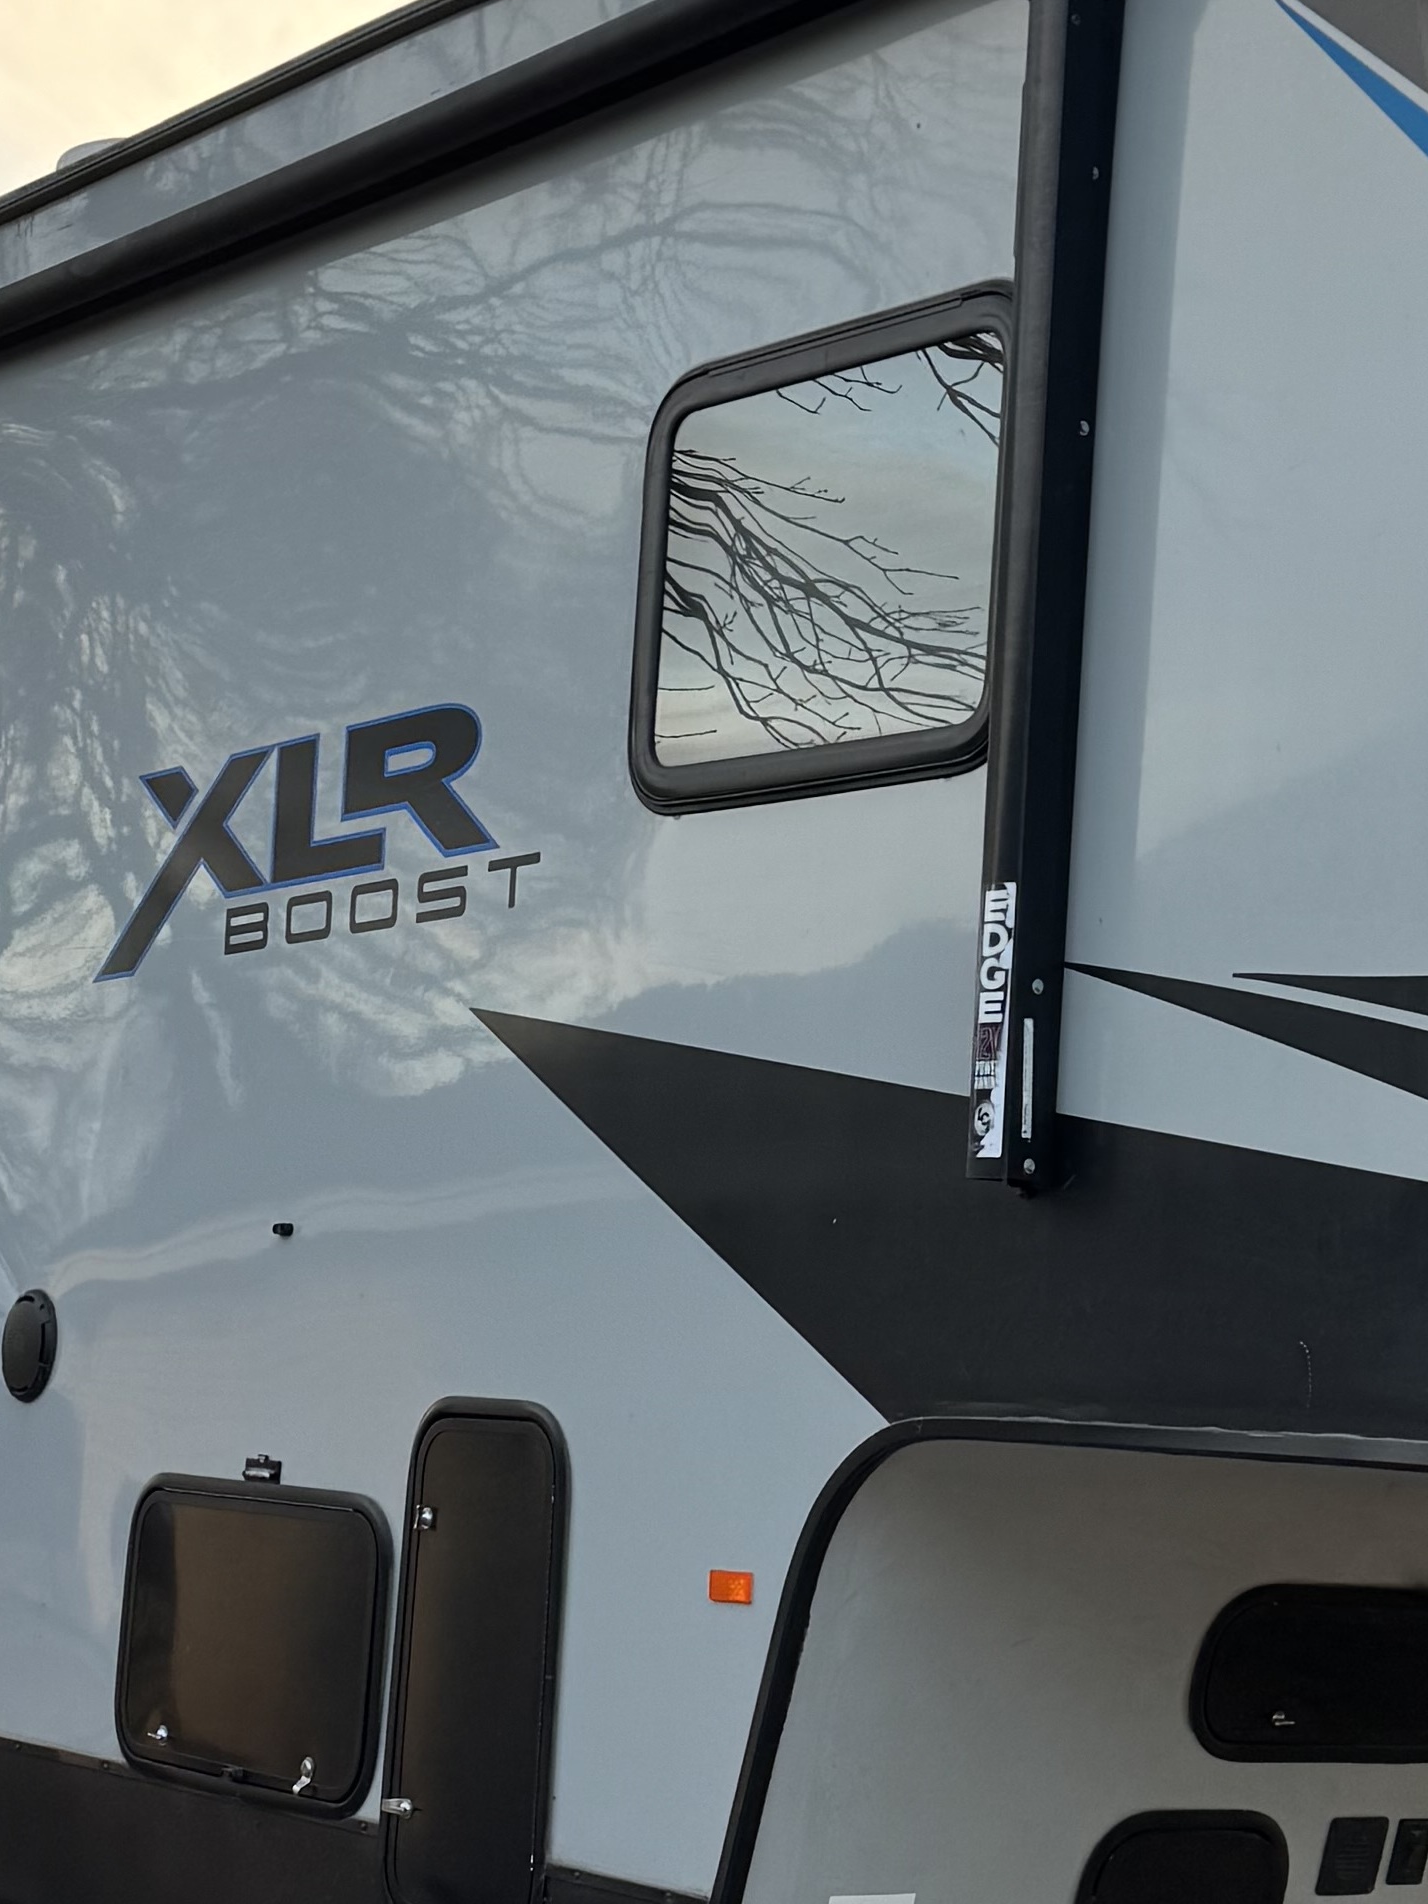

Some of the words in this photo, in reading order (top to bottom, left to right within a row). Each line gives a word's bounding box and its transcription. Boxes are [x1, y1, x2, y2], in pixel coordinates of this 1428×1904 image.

[92, 702, 500, 983] XLR
[224, 851, 541, 956] BOOST
[978, 889, 1010, 1023] EDGE
